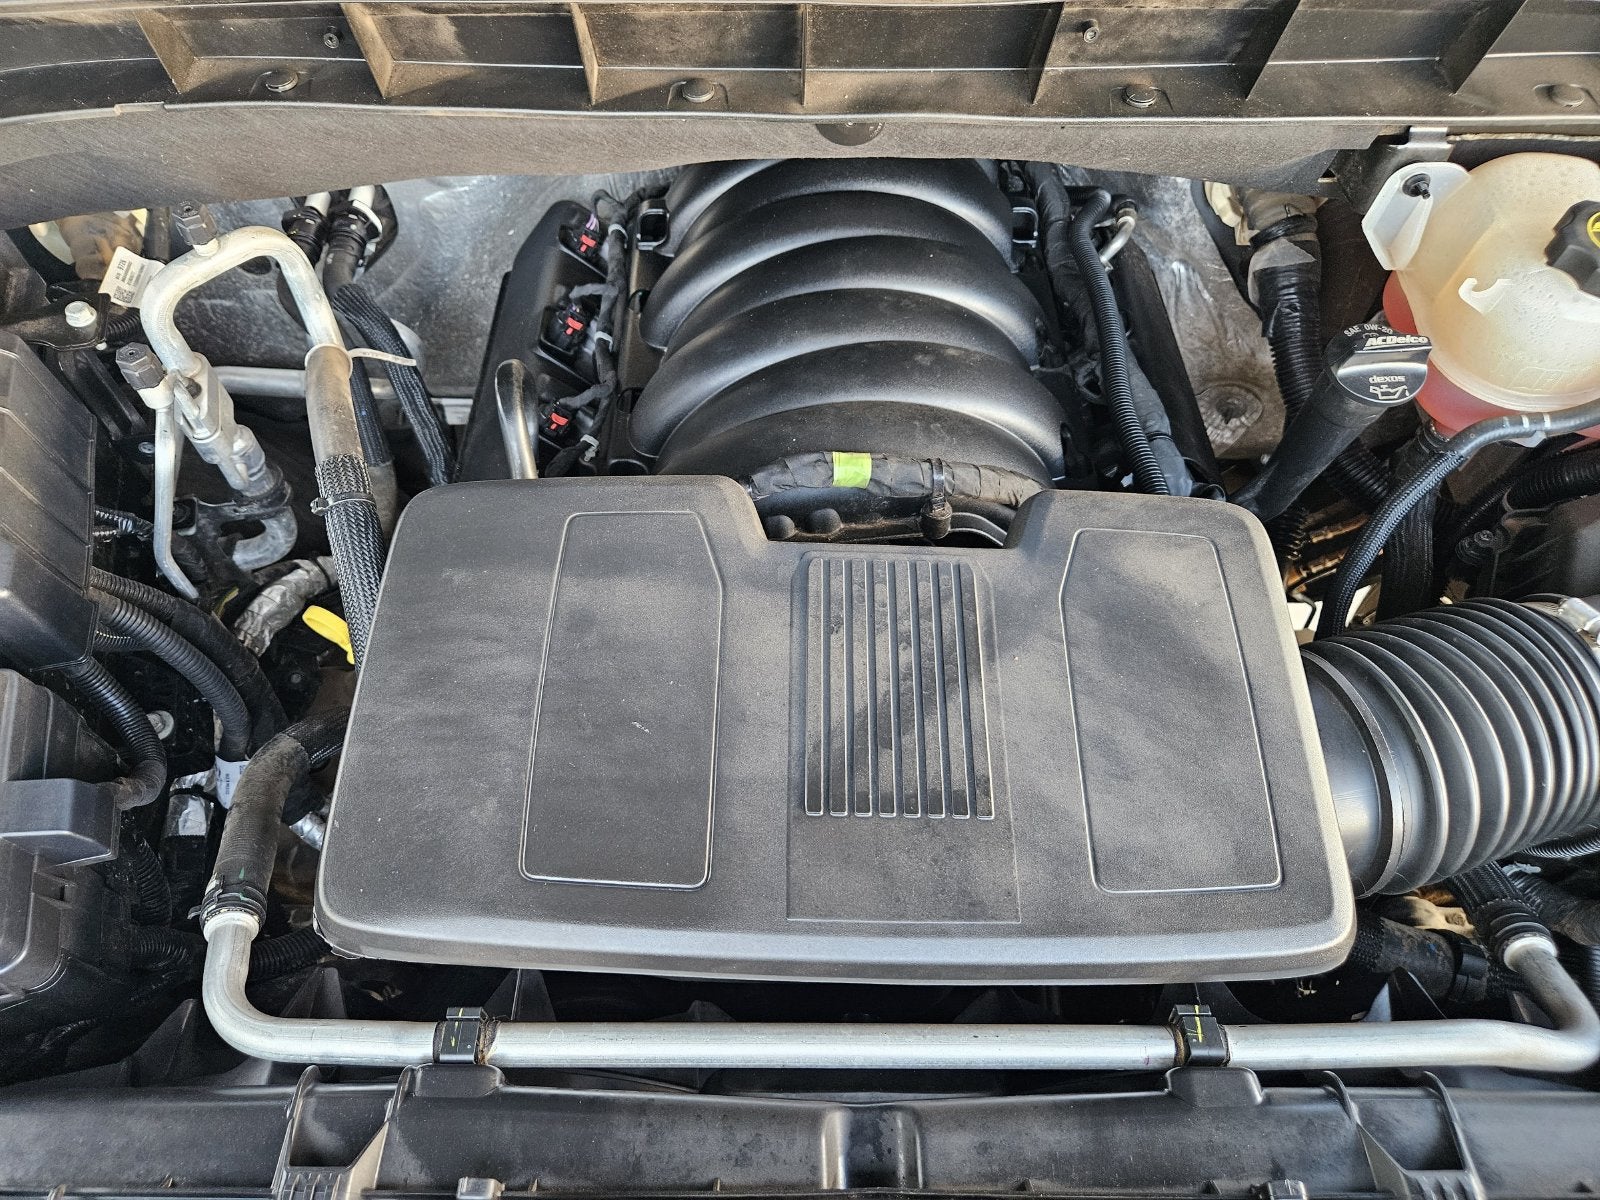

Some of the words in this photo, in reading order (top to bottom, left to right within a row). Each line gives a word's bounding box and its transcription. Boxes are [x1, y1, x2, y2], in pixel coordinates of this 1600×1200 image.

[1343, 326, 1362, 337] SAE
[1364, 323, 1394, 335] 0W-20
[1364, 334, 1429, 347] ACDelco
[1368, 375, 1406, 384] dexos
